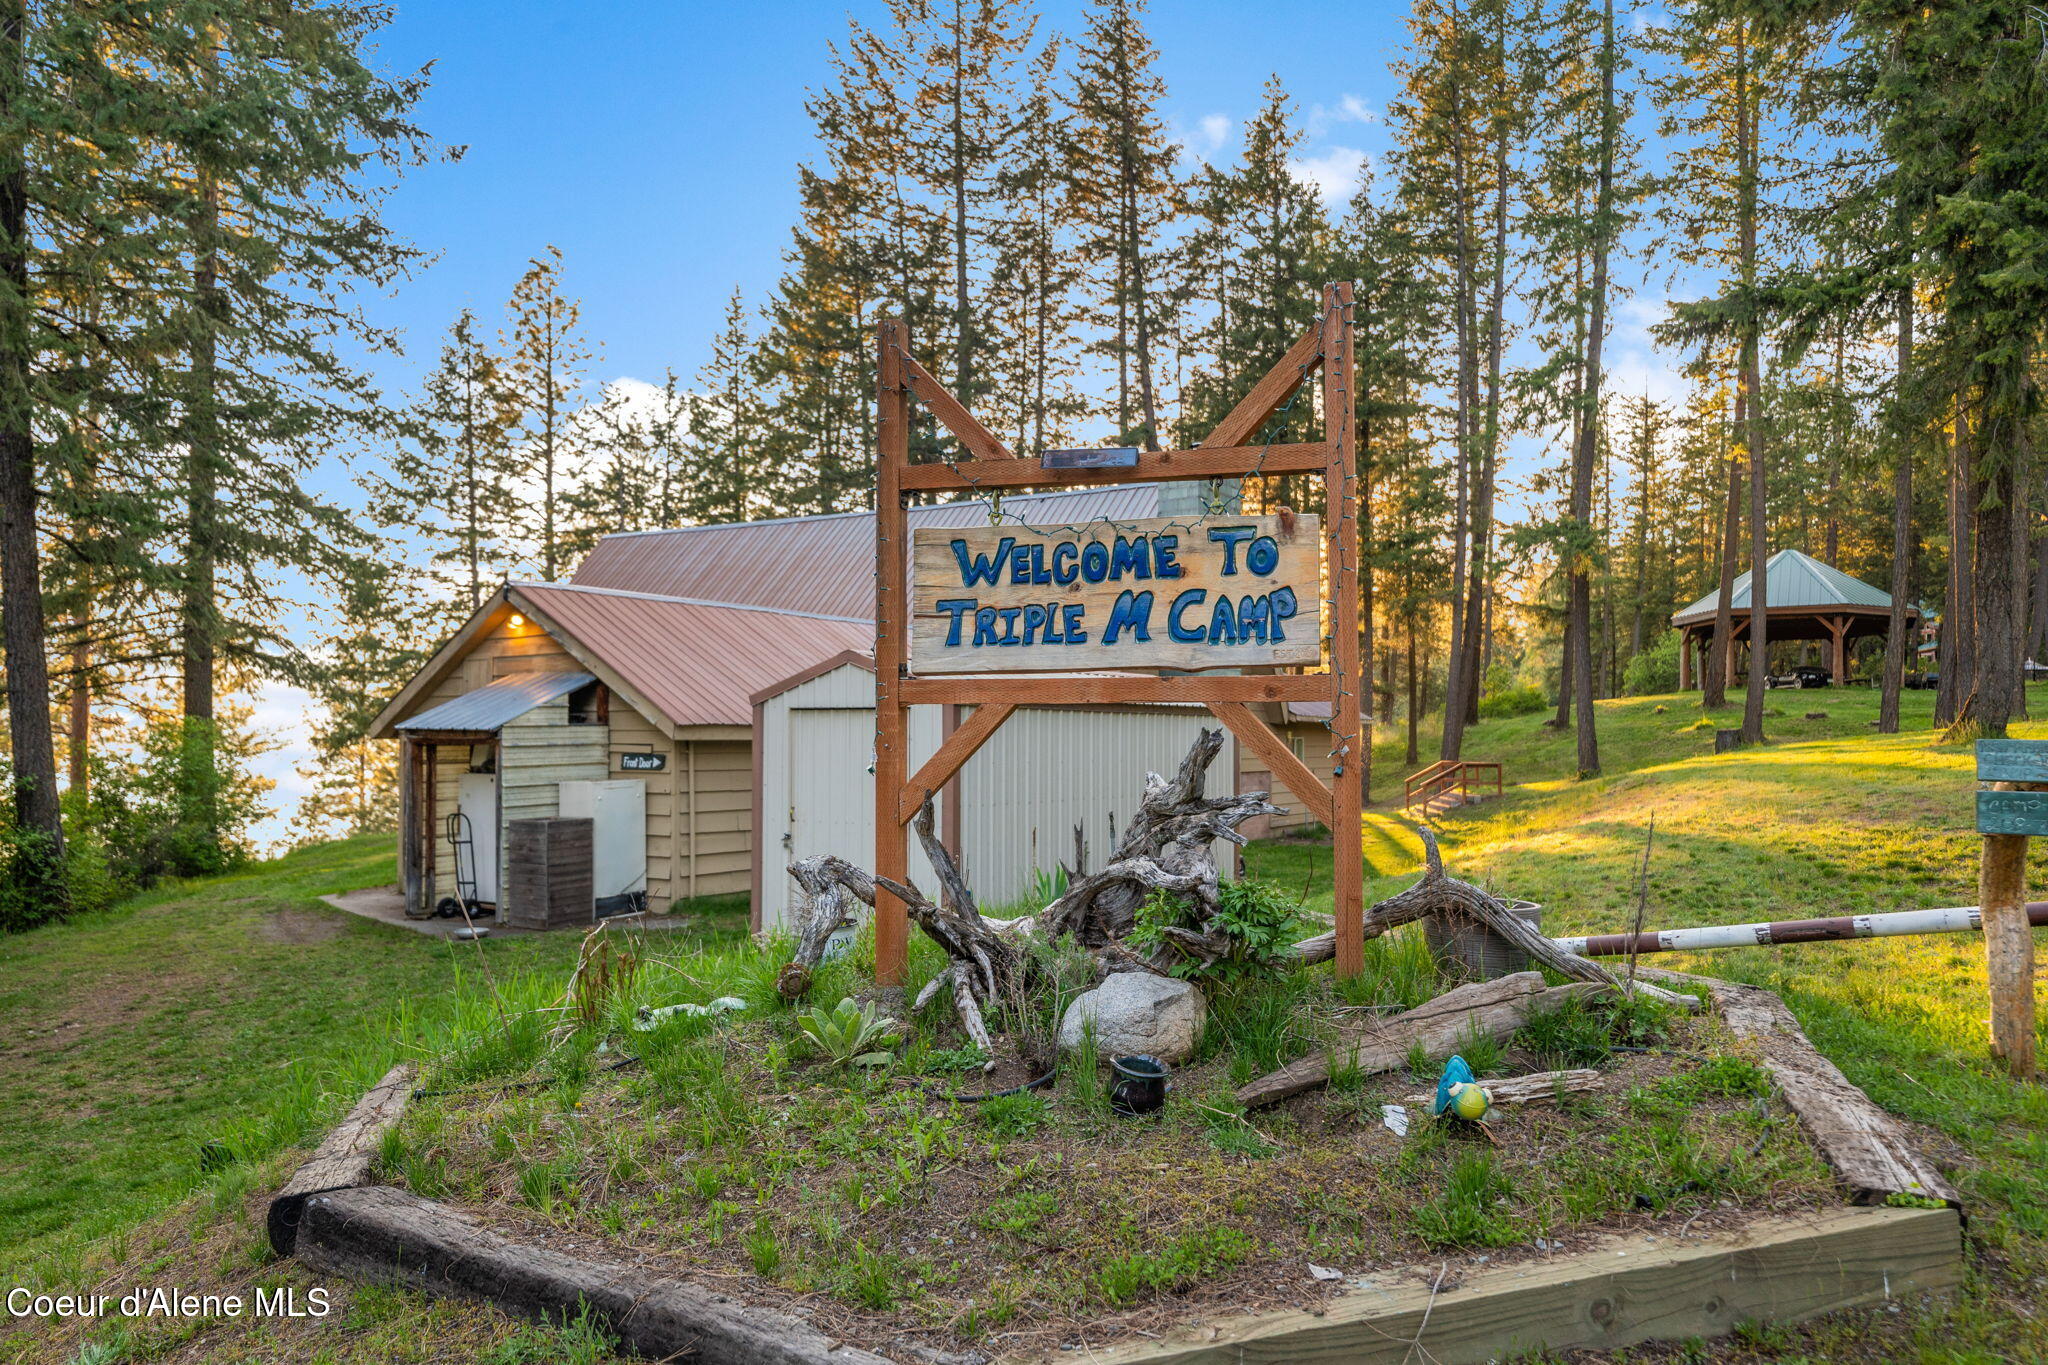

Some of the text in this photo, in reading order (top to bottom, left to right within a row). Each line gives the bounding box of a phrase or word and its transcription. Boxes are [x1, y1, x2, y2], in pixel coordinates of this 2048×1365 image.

[950, 534, 1183, 588] WELCOME
[935, 586, 1298, 648] TRIPLE M CAMP
[623, 756, 653, 769] Front Door
